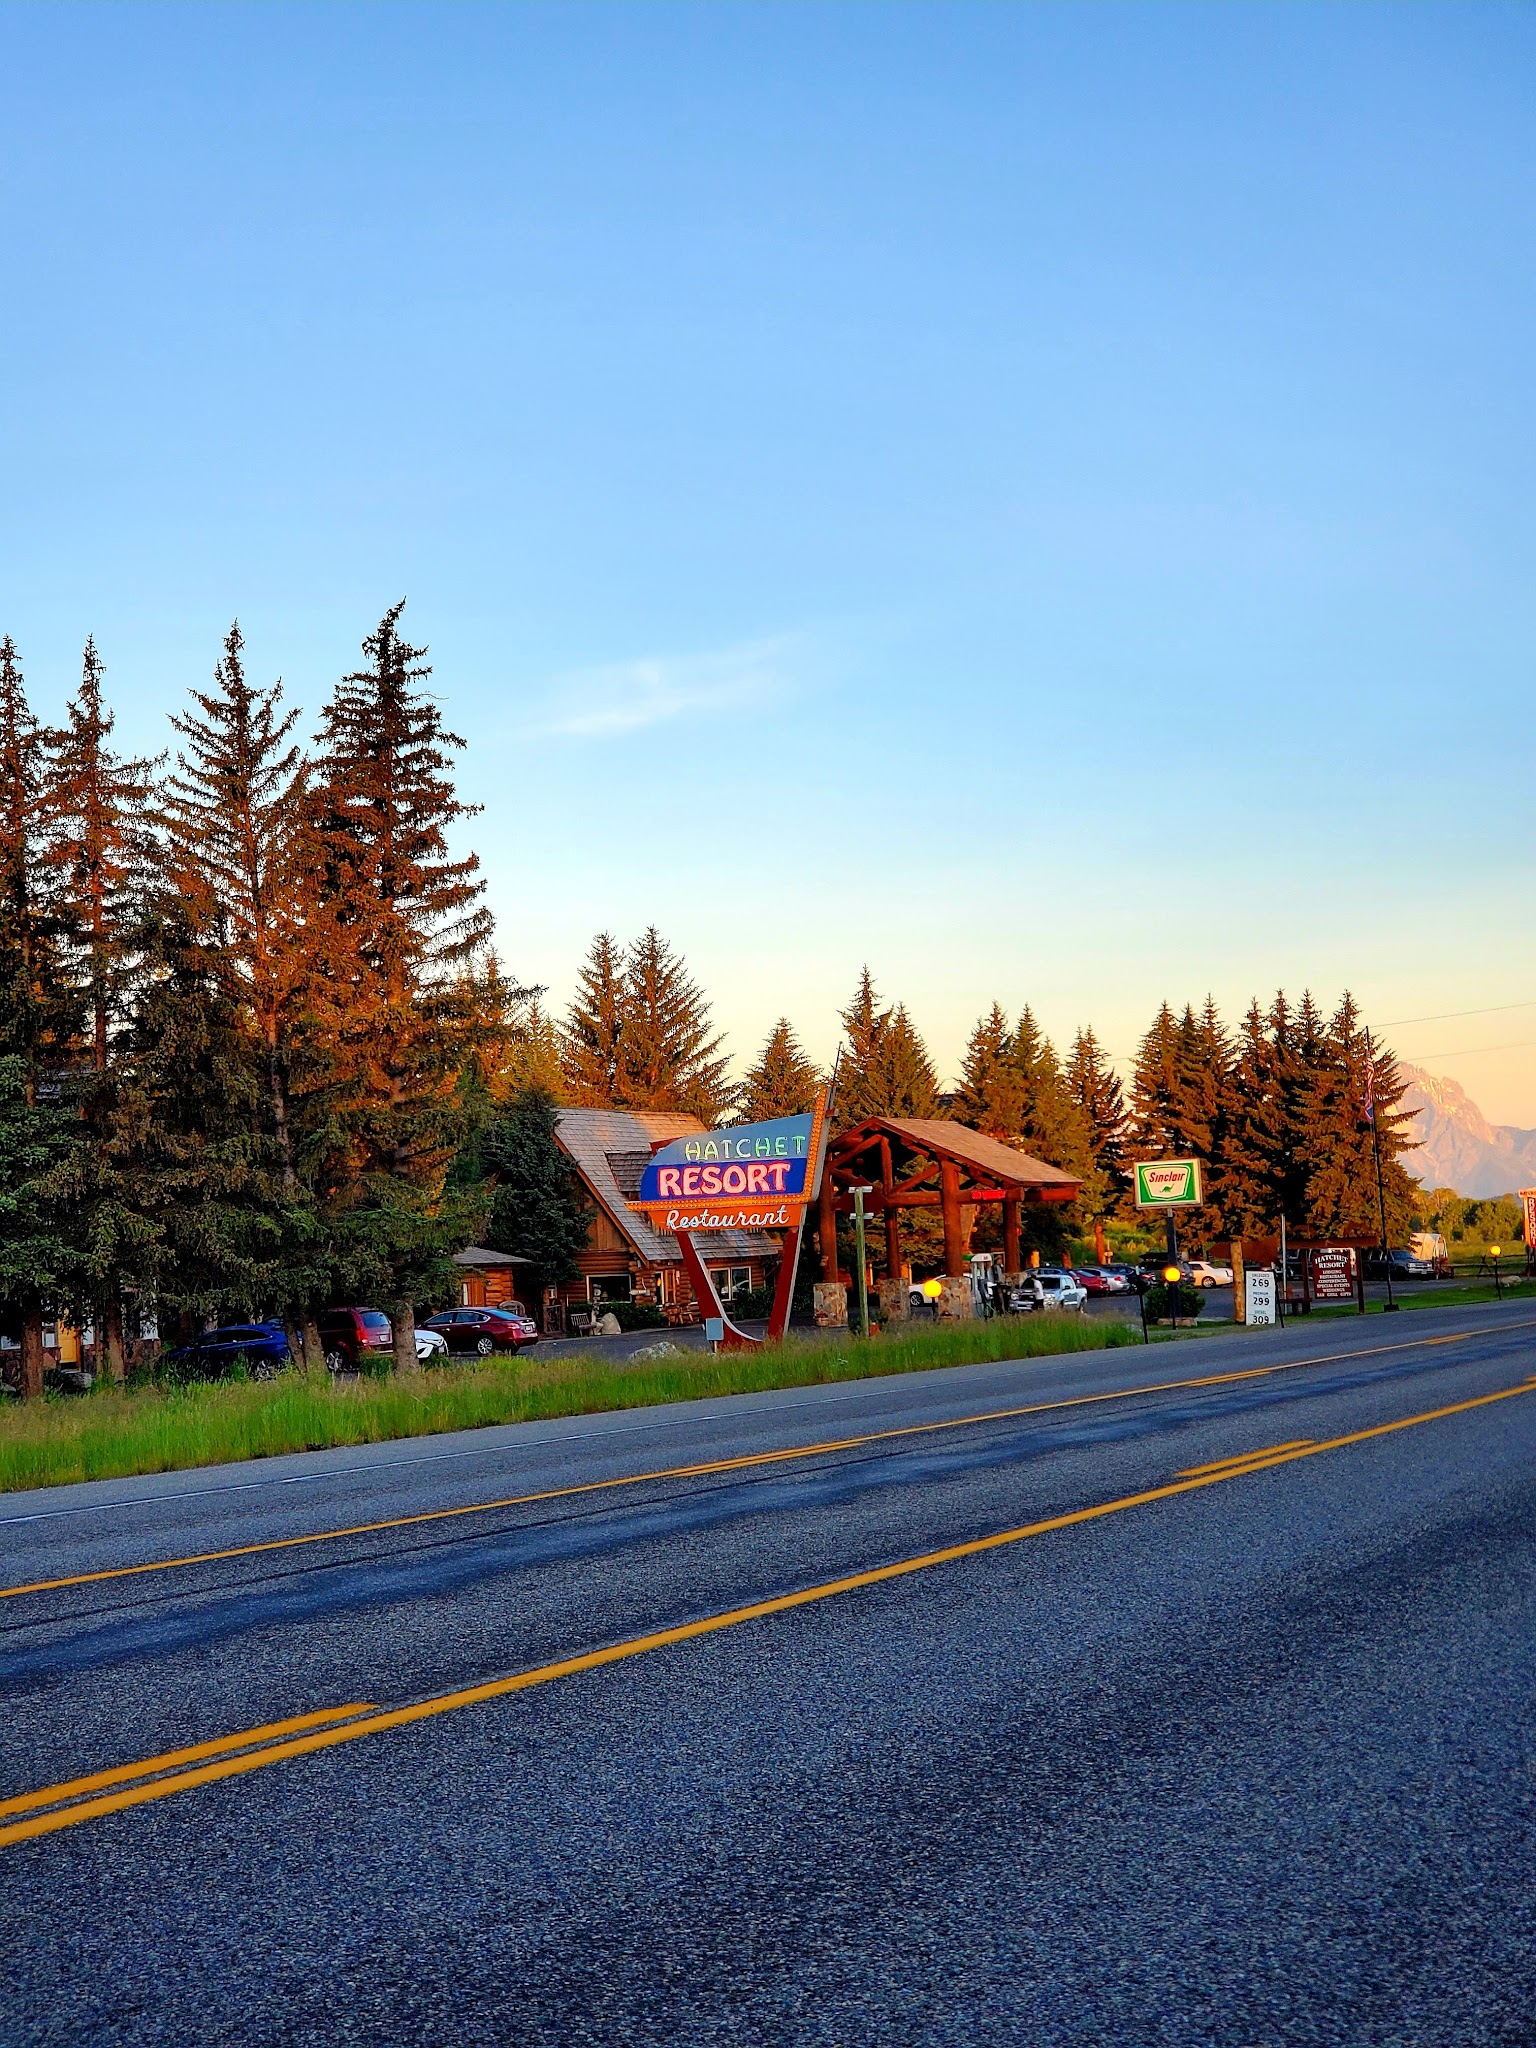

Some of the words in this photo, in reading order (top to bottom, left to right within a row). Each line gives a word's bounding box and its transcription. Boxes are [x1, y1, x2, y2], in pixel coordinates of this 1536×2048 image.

[685, 1136, 806, 1161] HATCHET
[657, 1161, 791, 1198] RESORT
[1149, 1171, 1185, 1182] Sinclair
[666, 1205, 790, 1230] Restaurant
[1314, 1254, 1348, 1264] HATCHET
[1252, 1279, 1269, 1287] 269
[1253, 1297, 1270, 1305] 299
[1253, 1316, 1269, 1324] 309
